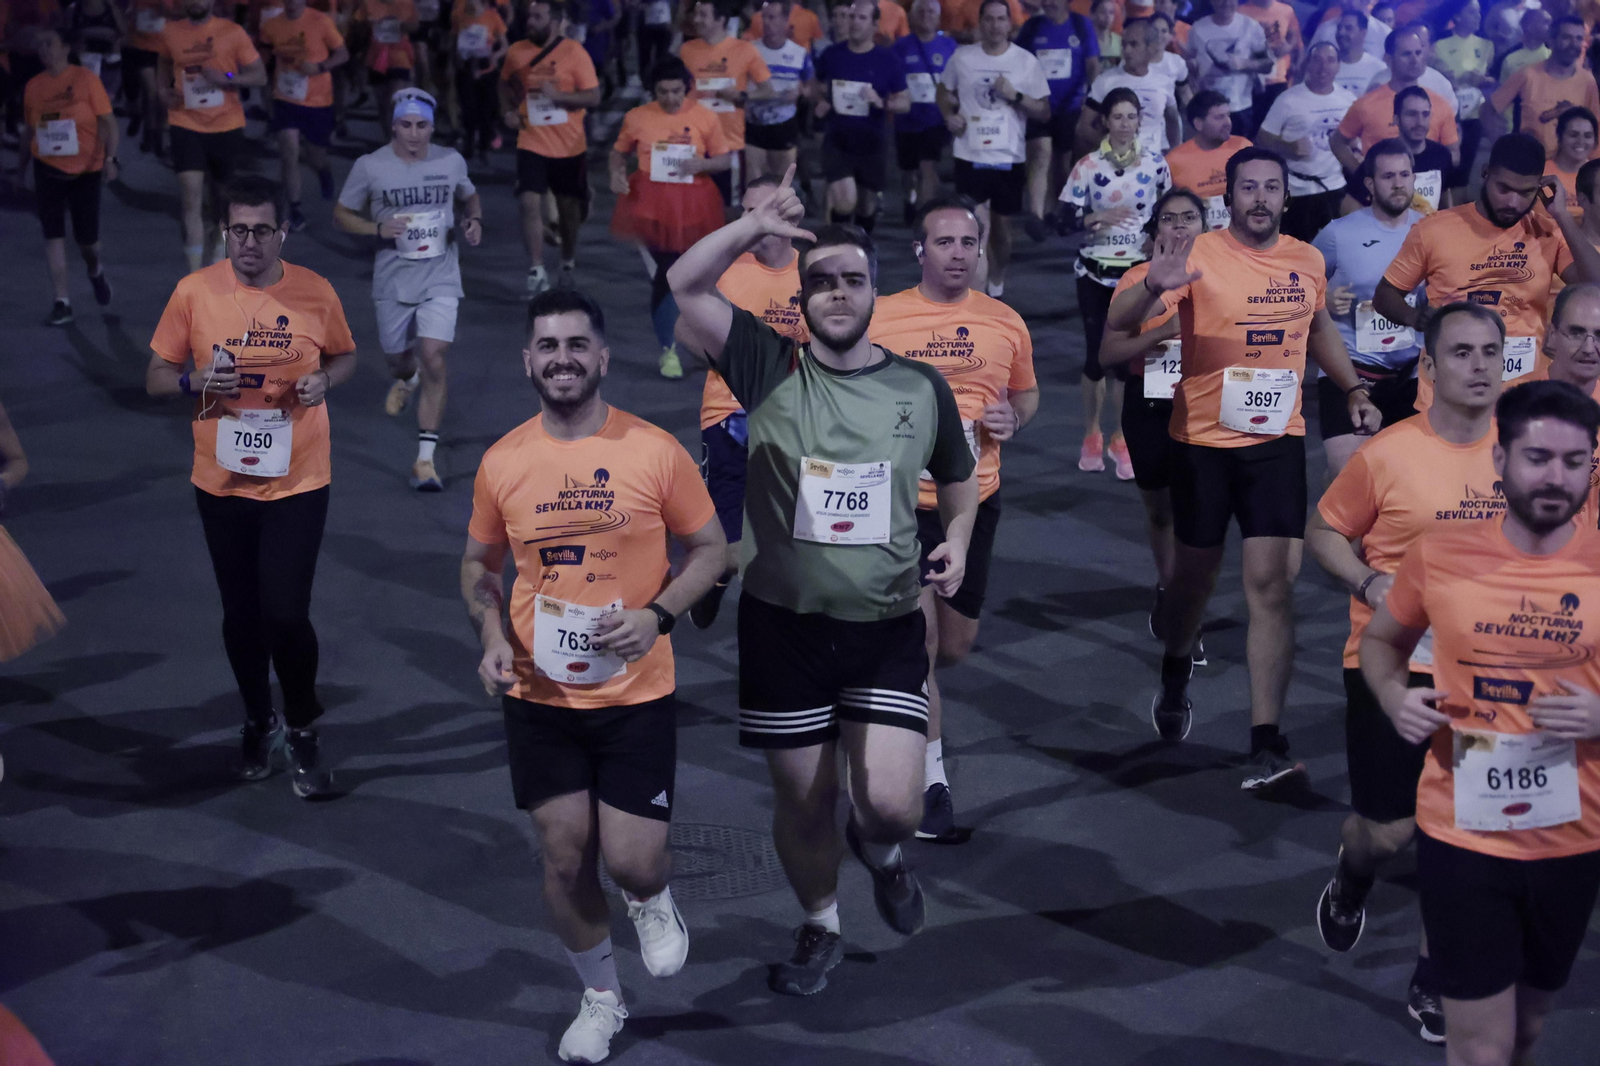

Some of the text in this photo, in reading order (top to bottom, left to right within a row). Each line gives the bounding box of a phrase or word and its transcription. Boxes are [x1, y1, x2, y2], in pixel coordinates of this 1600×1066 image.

[382, 184, 450, 207] ATHLETE
[1414, 186, 1435, 197] 908
[407, 226, 439, 240] 20846
[1106, 233, 1137, 246] 15263
[1486, 253, 1529, 261] NOCTURNA
[1470, 261, 1505, 271] SEVILLA
[1266, 287, 1306, 295] NOCTURNA
[1247, 295, 1286, 304] SEVILLA
[764, 309, 801, 318] NOCTURNA
[247, 330, 293, 340] NOCTURNA
[926, 341, 975, 349] NOCTURNA
[904, 350, 949, 358] SEVILLA
[1244, 390, 1282, 407] 3697
[233, 430, 273, 449] 7050
[558, 489, 615, 499] NOCTURNA
[823, 489, 869, 511] 7768
[1459, 500, 1508, 509] NOCTURN
[535, 500, 583, 514] SEVILLA
[1435, 510, 1484, 520] SEVILLA
[1508, 612, 1584, 630] NOCTURNA
[1473, 621, 1540, 640] SEVILLA
[1487, 764, 1548, 790] 6186
